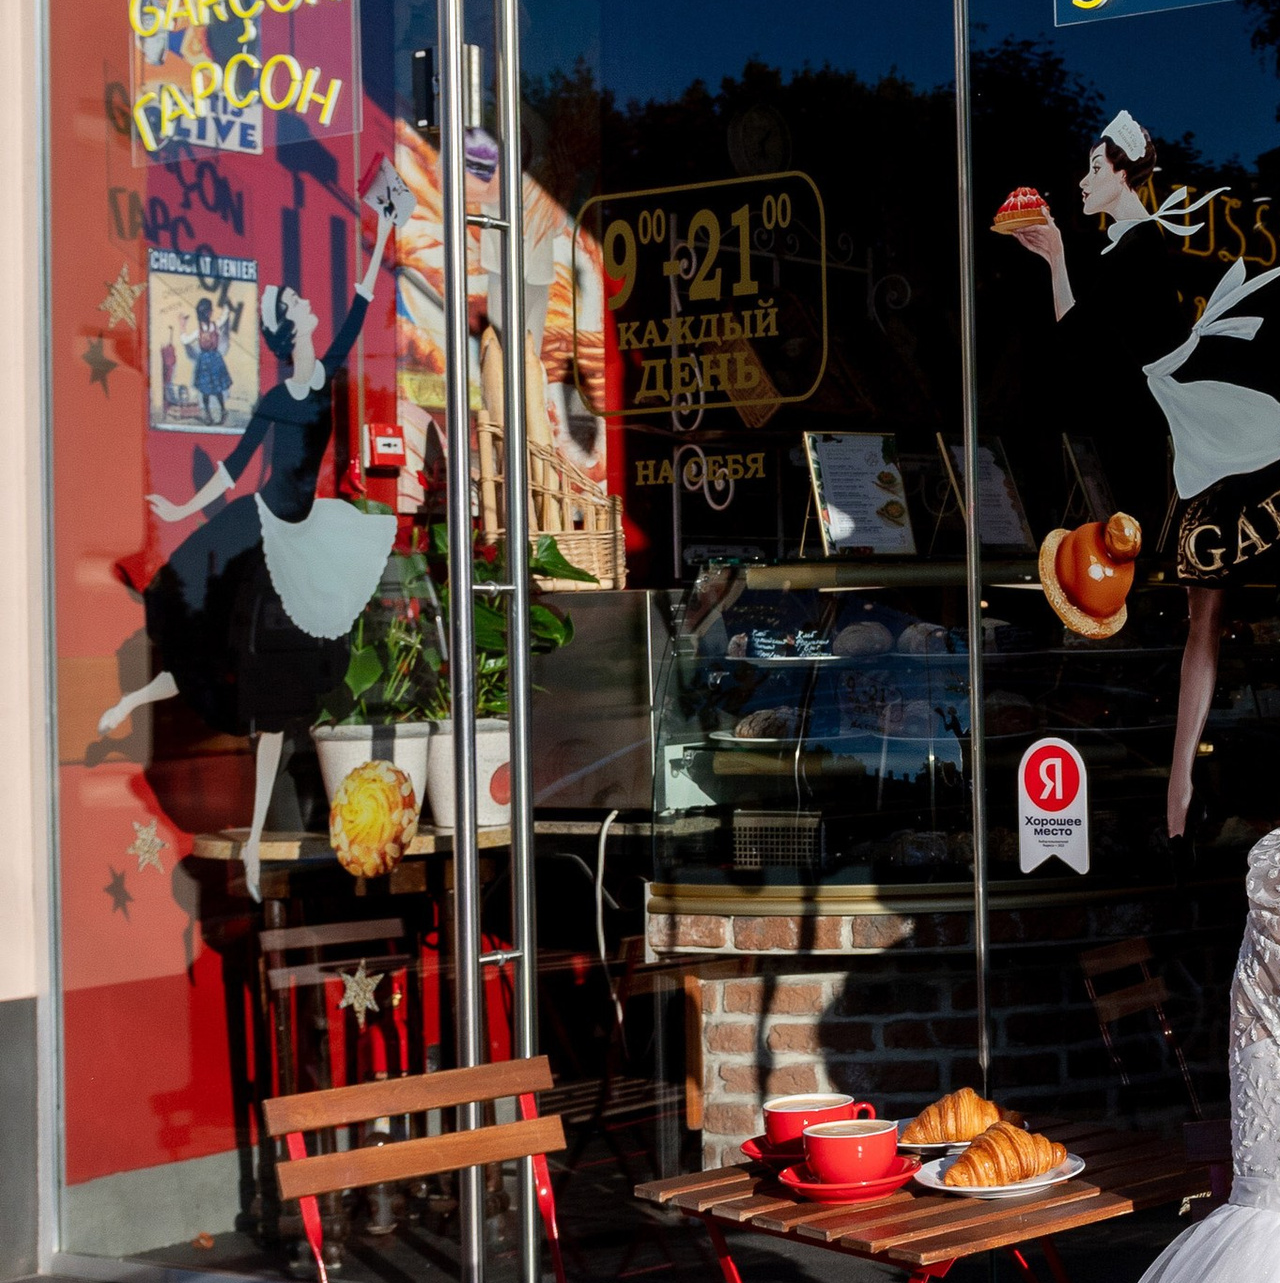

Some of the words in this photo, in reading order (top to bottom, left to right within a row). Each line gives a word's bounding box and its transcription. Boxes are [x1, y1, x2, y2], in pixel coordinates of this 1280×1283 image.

[133, 53, 342, 151] ГАРСОН
[617, 299, 779, 350] КАЖДЫЙ
[634, 351, 762, 404] ДЕНЬ
[635, 459, 675, 486] НА
[688, 453, 766, 484] СЕБЯ
[1039, 757, 1063, 800] Я
[1025, 816, 1082, 827] Хорошее
[1034, 828, 1073, 836] место
